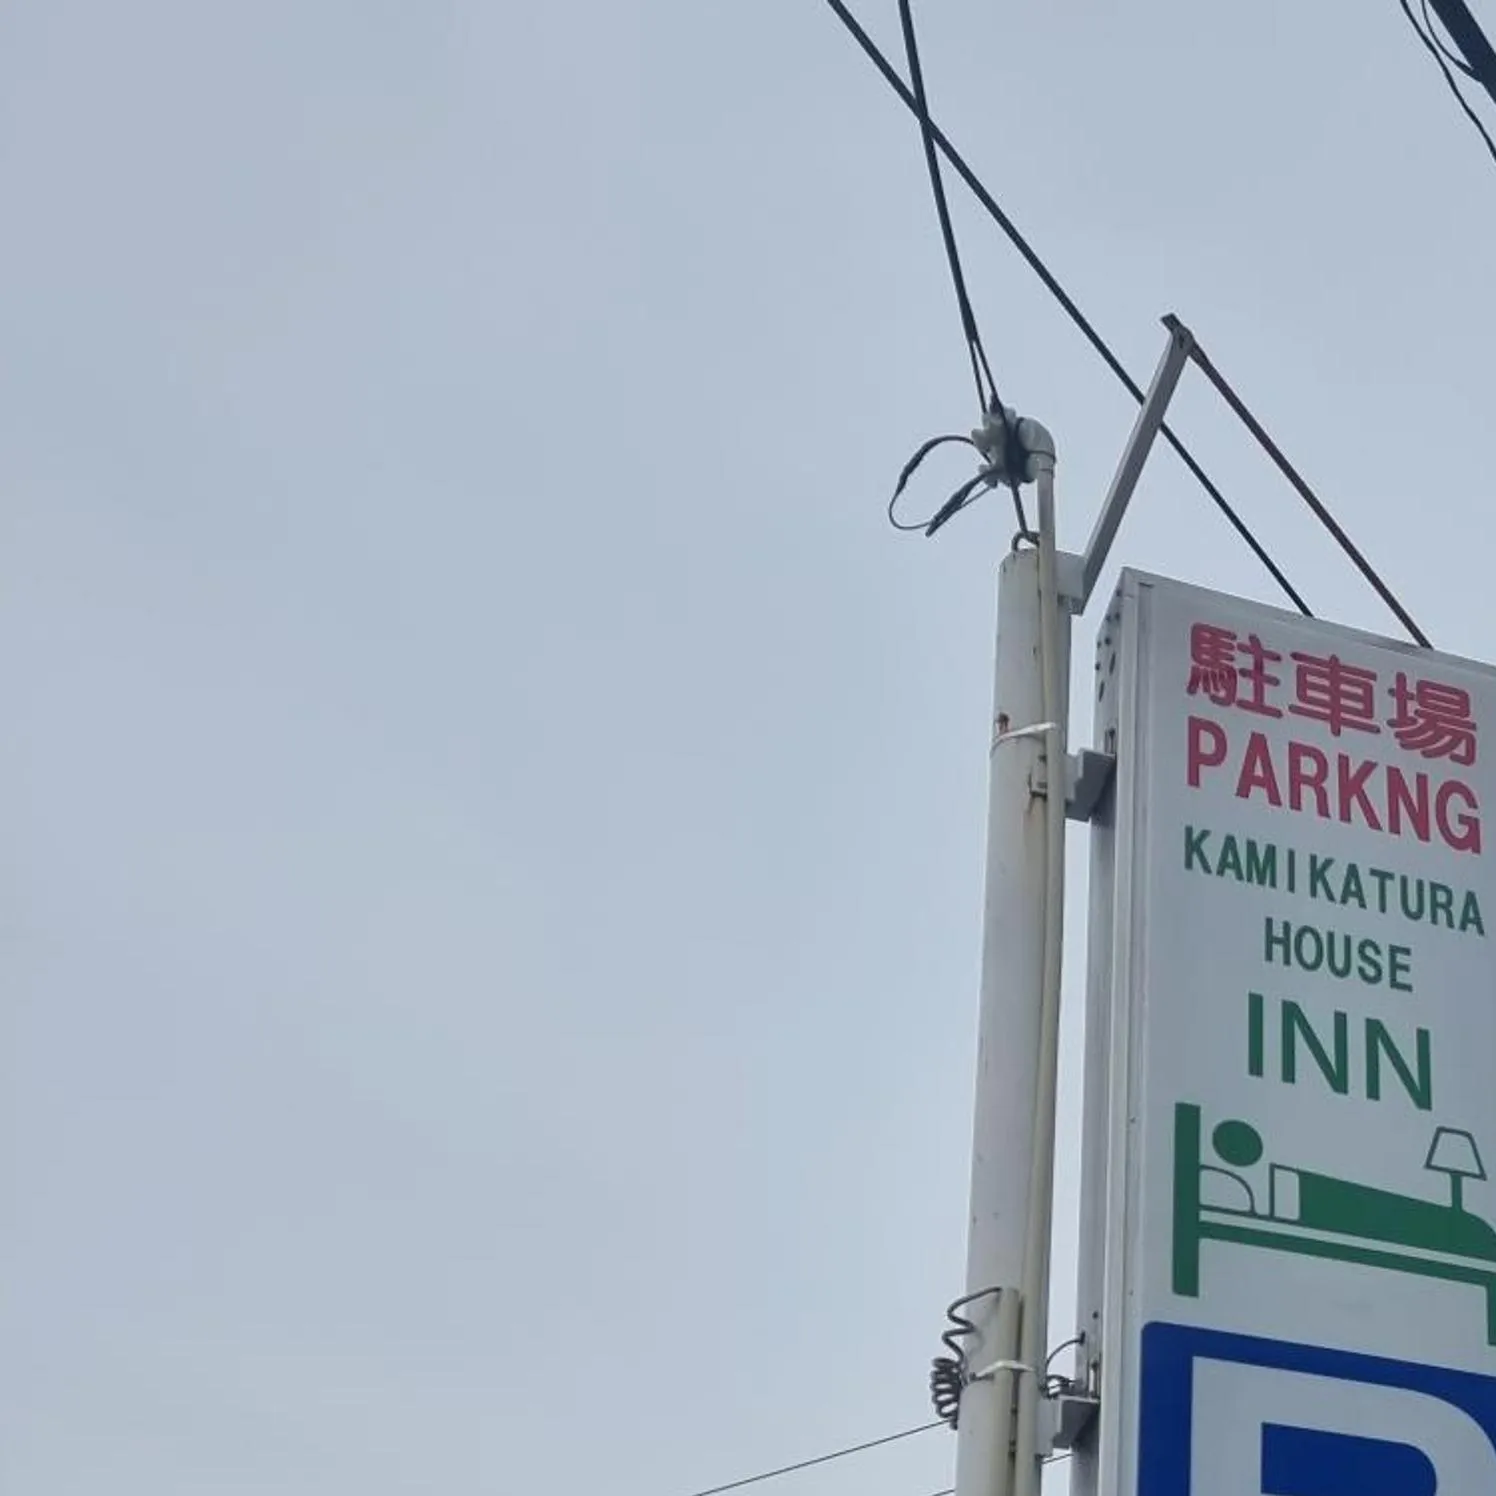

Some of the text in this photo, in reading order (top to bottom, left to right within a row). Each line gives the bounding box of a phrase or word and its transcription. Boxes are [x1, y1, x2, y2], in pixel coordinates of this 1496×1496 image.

[1185, 622, 1478, 767] 駐車場
[1186, 715, 1482, 855] PARKNG
[1184, 825, 1486, 937] KAMIKATURA
[1264, 916, 1414, 993] HOUSE
[1247, 992, 1433, 1111] INN
